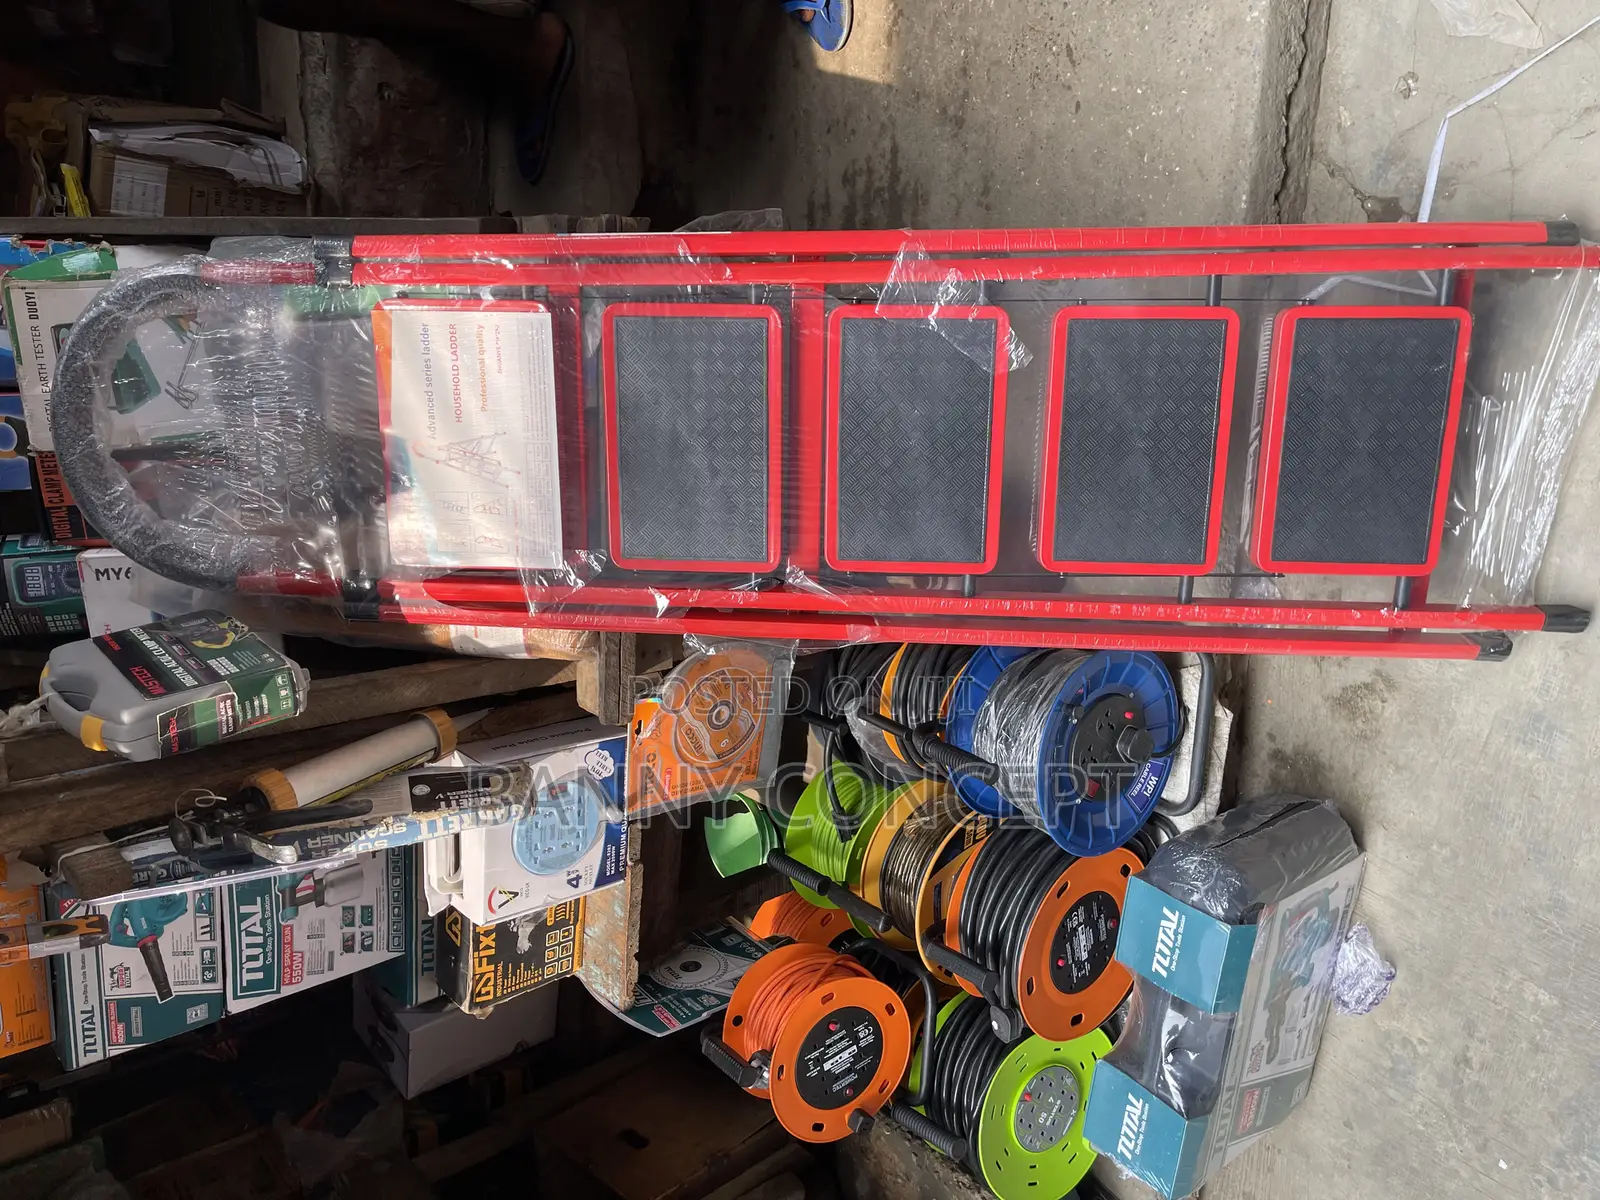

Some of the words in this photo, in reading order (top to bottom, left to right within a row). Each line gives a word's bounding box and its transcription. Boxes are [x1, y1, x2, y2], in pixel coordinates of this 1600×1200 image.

[25, 291, 38, 320] DUOYI
[29, 325, 41, 361] TESTER
[421, 323, 430, 356] ladder
[448, 323, 457, 363] LADDER
[476, 324, 486, 358] quality
[37, 363, 50, 394] EARTH
[424, 358, 433, 389] series
[478, 360, 488, 412] Professional
[451, 365, 463, 423] HOUSEHOLD
[424, 392, 436, 440] Advanced
[39, 451, 59, 476] METE
[45, 477, 64, 504] CLAMP
[51, 507, 72, 539] DIGITAL
[129, 665, 168, 695] MASTECH
[169, 717, 179, 754] MASTECH
[518, 735, 548, 746] Cable
[1138, 763, 1152, 783] CABLE
[1143, 775, 1159, 797] WPI
[439, 796, 492, 811] RRETT
[1130, 782, 1143, 797] REEL
[306, 821, 408, 849] SCANNER
[311, 838, 389, 858] SUPER
[619, 833, 627, 871] PREMIUM
[566, 874, 583, 889] 4
[1177, 914, 1187, 934] Station
[240, 897, 264, 987] TOTAL
[421, 918, 435, 977] TOTAL
[1151, 906, 1179, 979] TOTAL
[1175, 933, 1183, 948] Tools
[292, 952, 302, 983] 550W
[664, 966, 683, 981] TOTAL
[1170, 948, 1181, 972] One-Stop
[283, 967, 291, 984] HVLP
[496, 960, 504, 997] INDUSTRIAL
[80, 1004, 98, 1058] TOTAL
[832, 1073, 858, 1093] POWERTEC
[1037, 1111, 1048, 1124] 50
[1046, 1098, 1062, 1127] STATUS
[1141, 1102, 1150, 1120] Station
[1214, 1085, 1235, 1154] TOTAL
[1117, 1092, 1144, 1161] TOTAL
[1139, 1118, 1147, 1134] Tools
[1134, 1133, 1145, 1156] One-Stop
